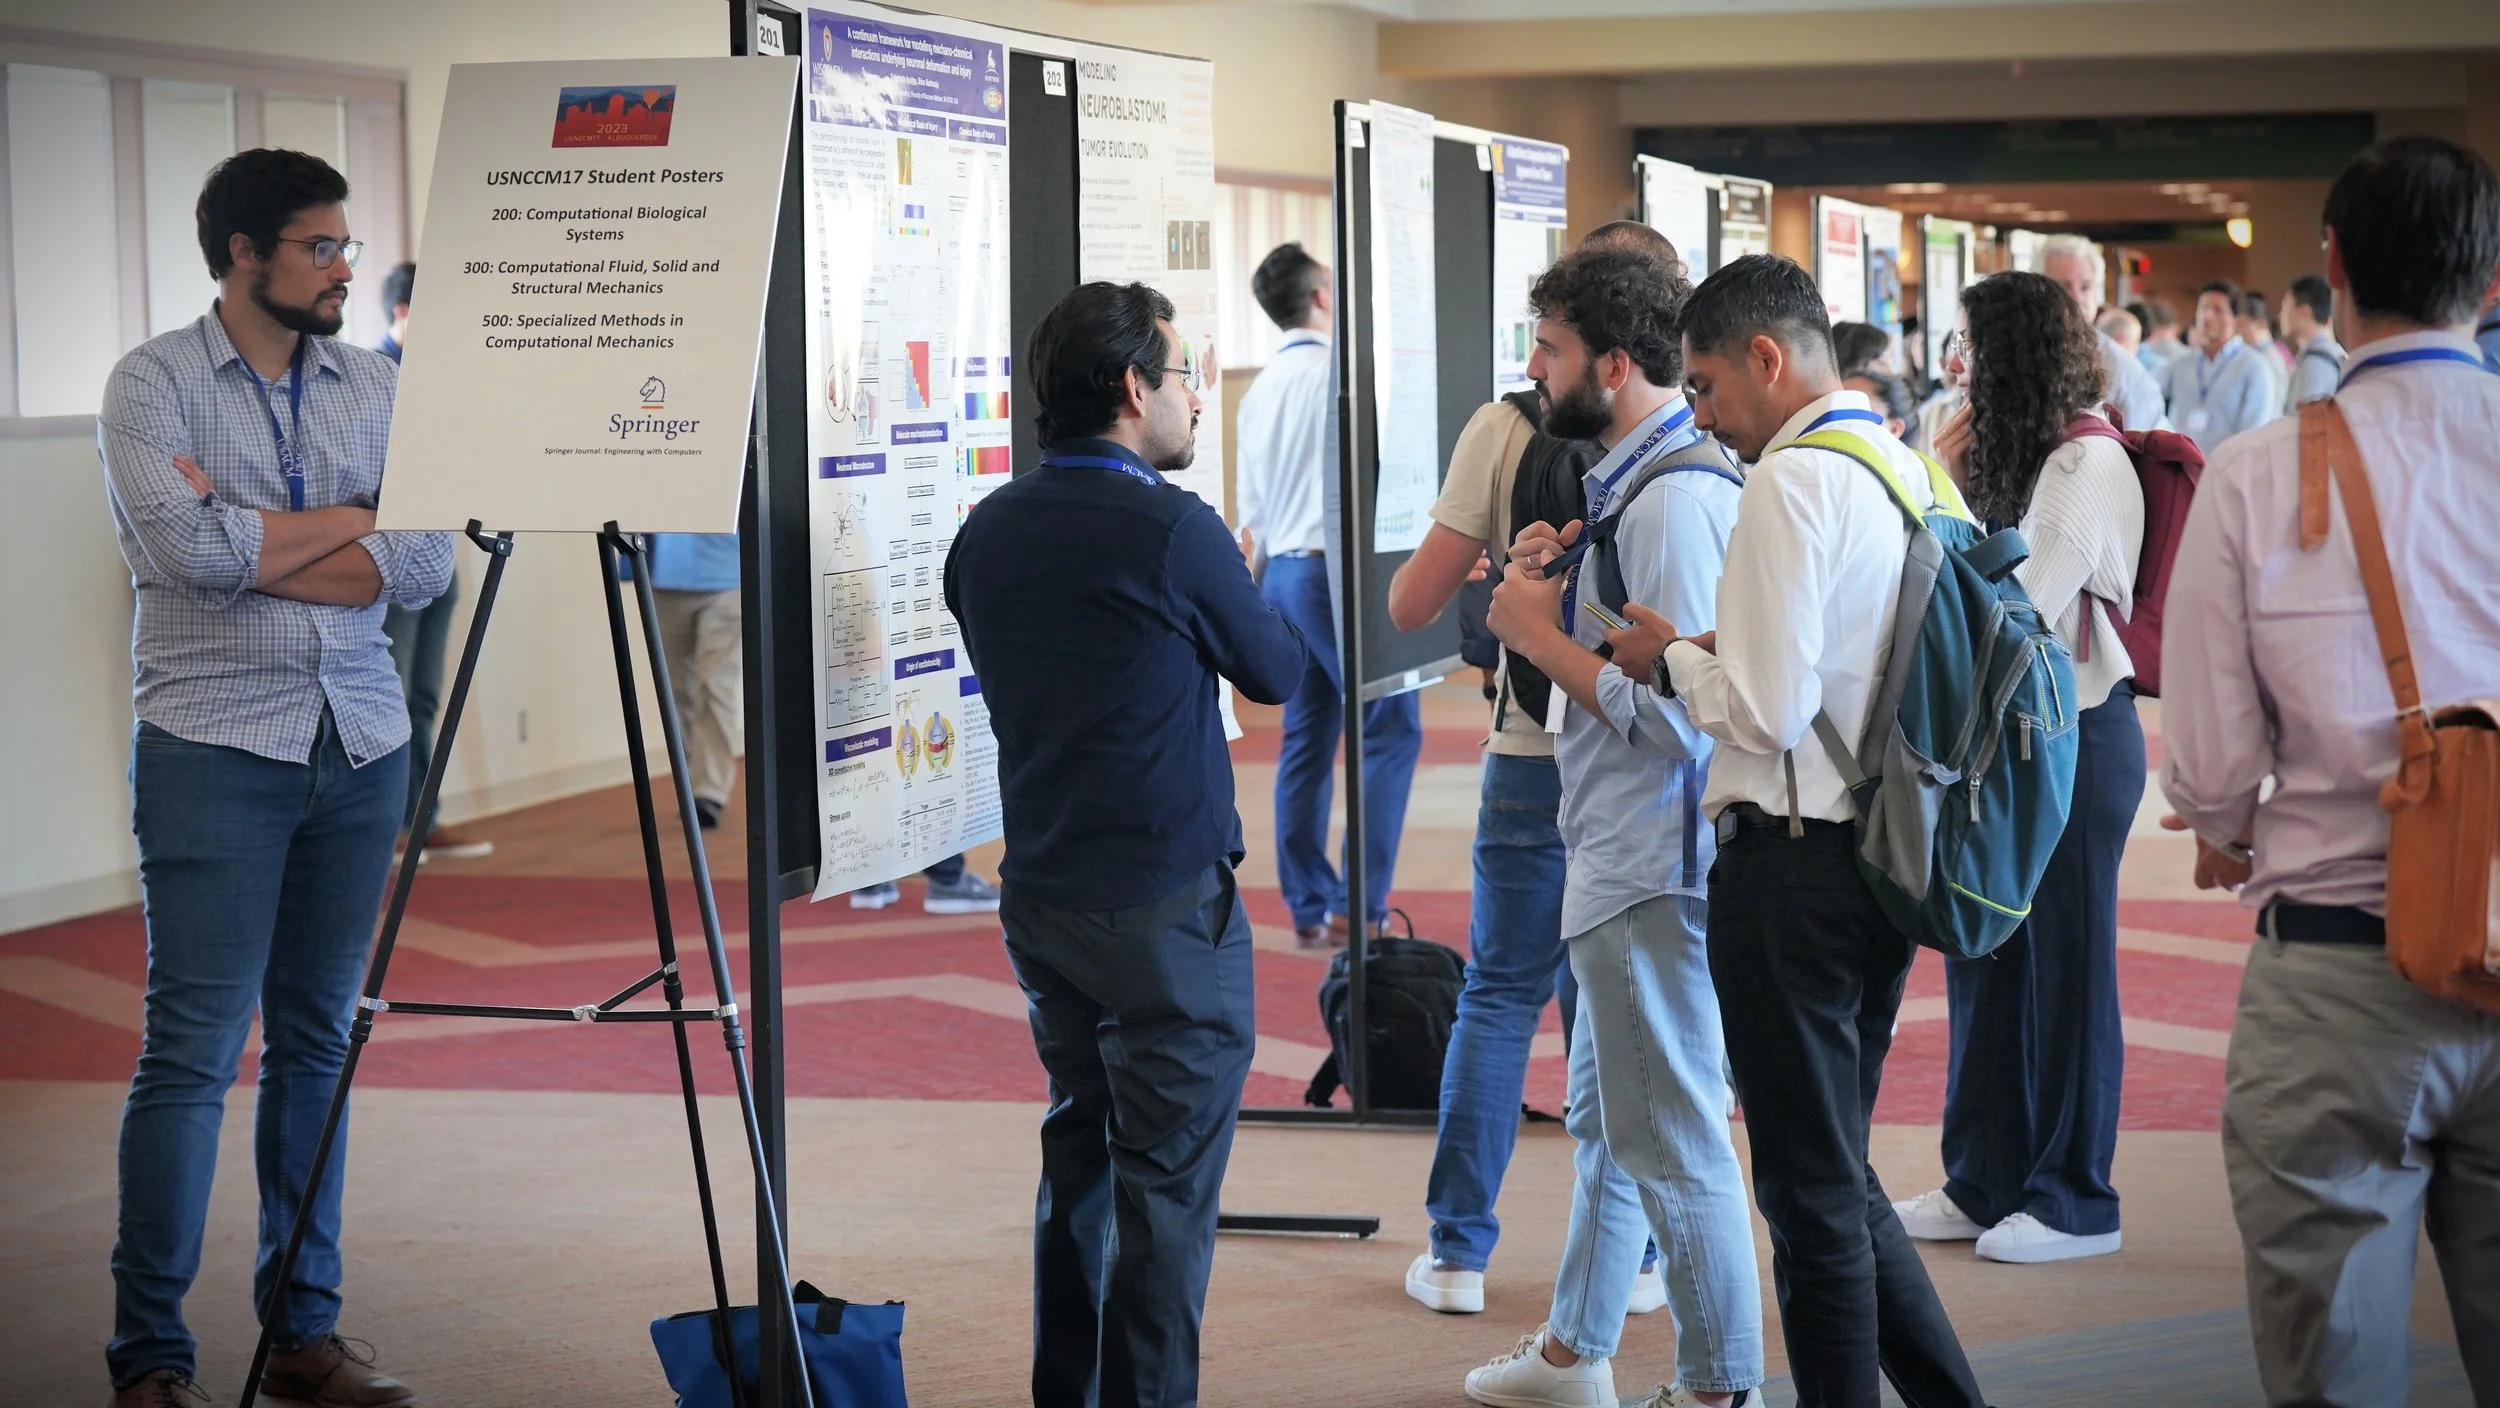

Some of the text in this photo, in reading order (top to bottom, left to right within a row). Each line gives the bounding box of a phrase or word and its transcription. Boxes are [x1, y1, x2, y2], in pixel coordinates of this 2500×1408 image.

[759, 25, 780, 49] 201
[879, 32, 904, 48] framework
[911, 39, 933, 55] modeling
[850, 46, 881, 62] interactions
[880, 52, 906, 69] underlying
[951, 64, 960, 75] and
[959, 65, 972, 80] injury
[1078, 60, 1117, 81] MODELING
[1047, 70, 1062, 87] 202
[1079, 93, 1167, 124] NEUROBLASTOMA
[596, 123, 629, 134] 2023
[564, 134, 600, 142] USNCCM17
[607, 134, 658, 142] ALBUQUERQUE
[1081, 138, 1149, 159] TUMOR EVOLUTION
[486, 168, 724, 186] USNCCM17 Student Posters
[491, 205, 707, 223] 200: Computational Biological
[565, 228, 625, 244] Systems
[463, 259, 721, 277] 300: Computational Fluid, Solid and
[511, 280, 664, 295] Structural Mechanics
[481, 313, 684, 330] 500: Specialized Methods in
[485, 335, 675, 352] Computational Mechanics
[608, 413, 701, 441] Springer
[544, 447, 703, 457] Springer Journal: Engineering with Computers
